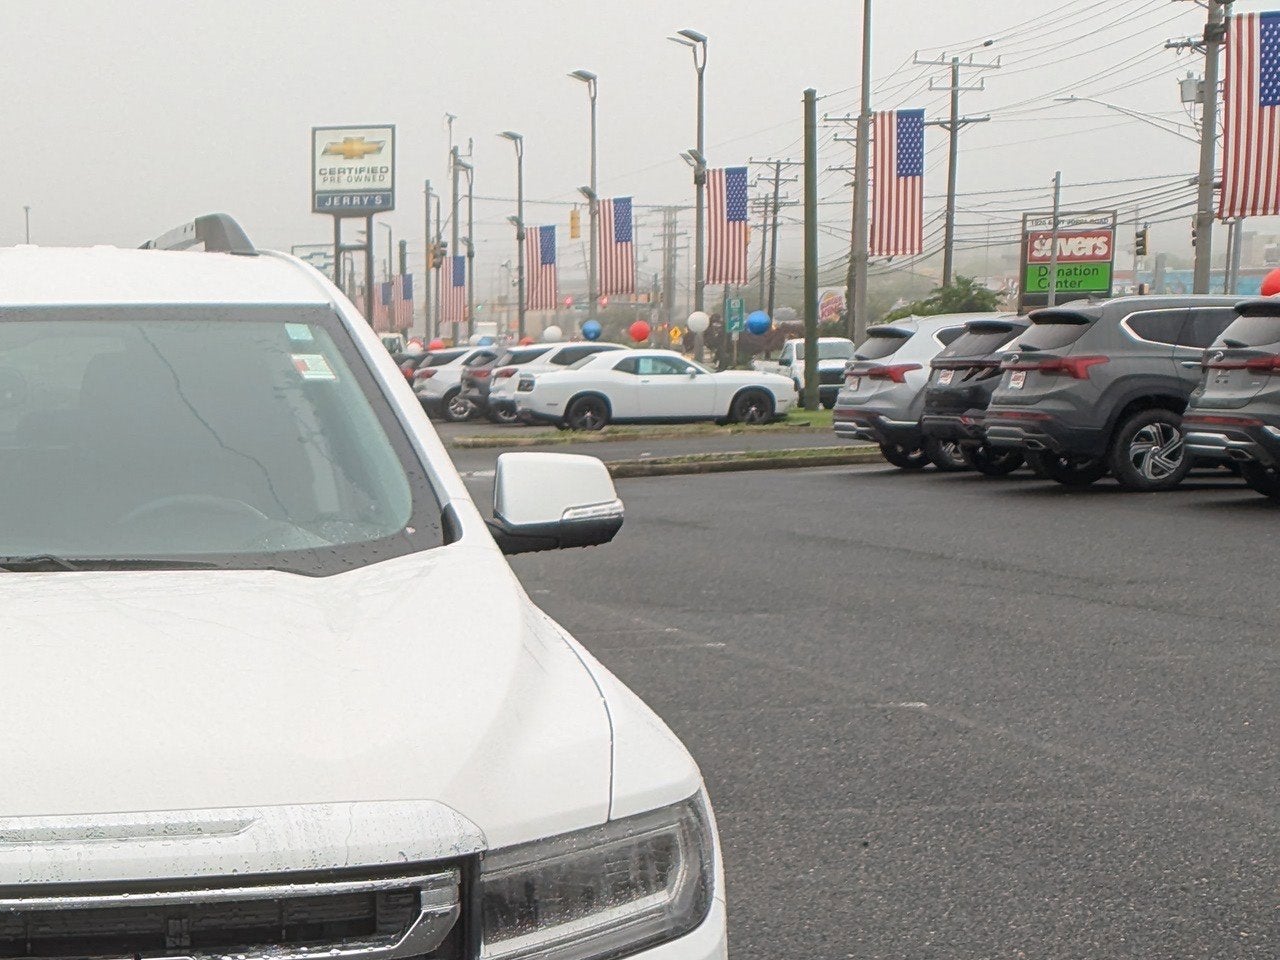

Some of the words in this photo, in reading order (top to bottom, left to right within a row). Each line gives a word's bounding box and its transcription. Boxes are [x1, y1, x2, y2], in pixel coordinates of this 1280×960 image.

[318, 166, 389, 175] CERTIFIED
[324, 195, 383, 206] JERRY'S
[1038, 265, 1099, 277] Dnation
[1037, 277, 1083, 289] Cnter
